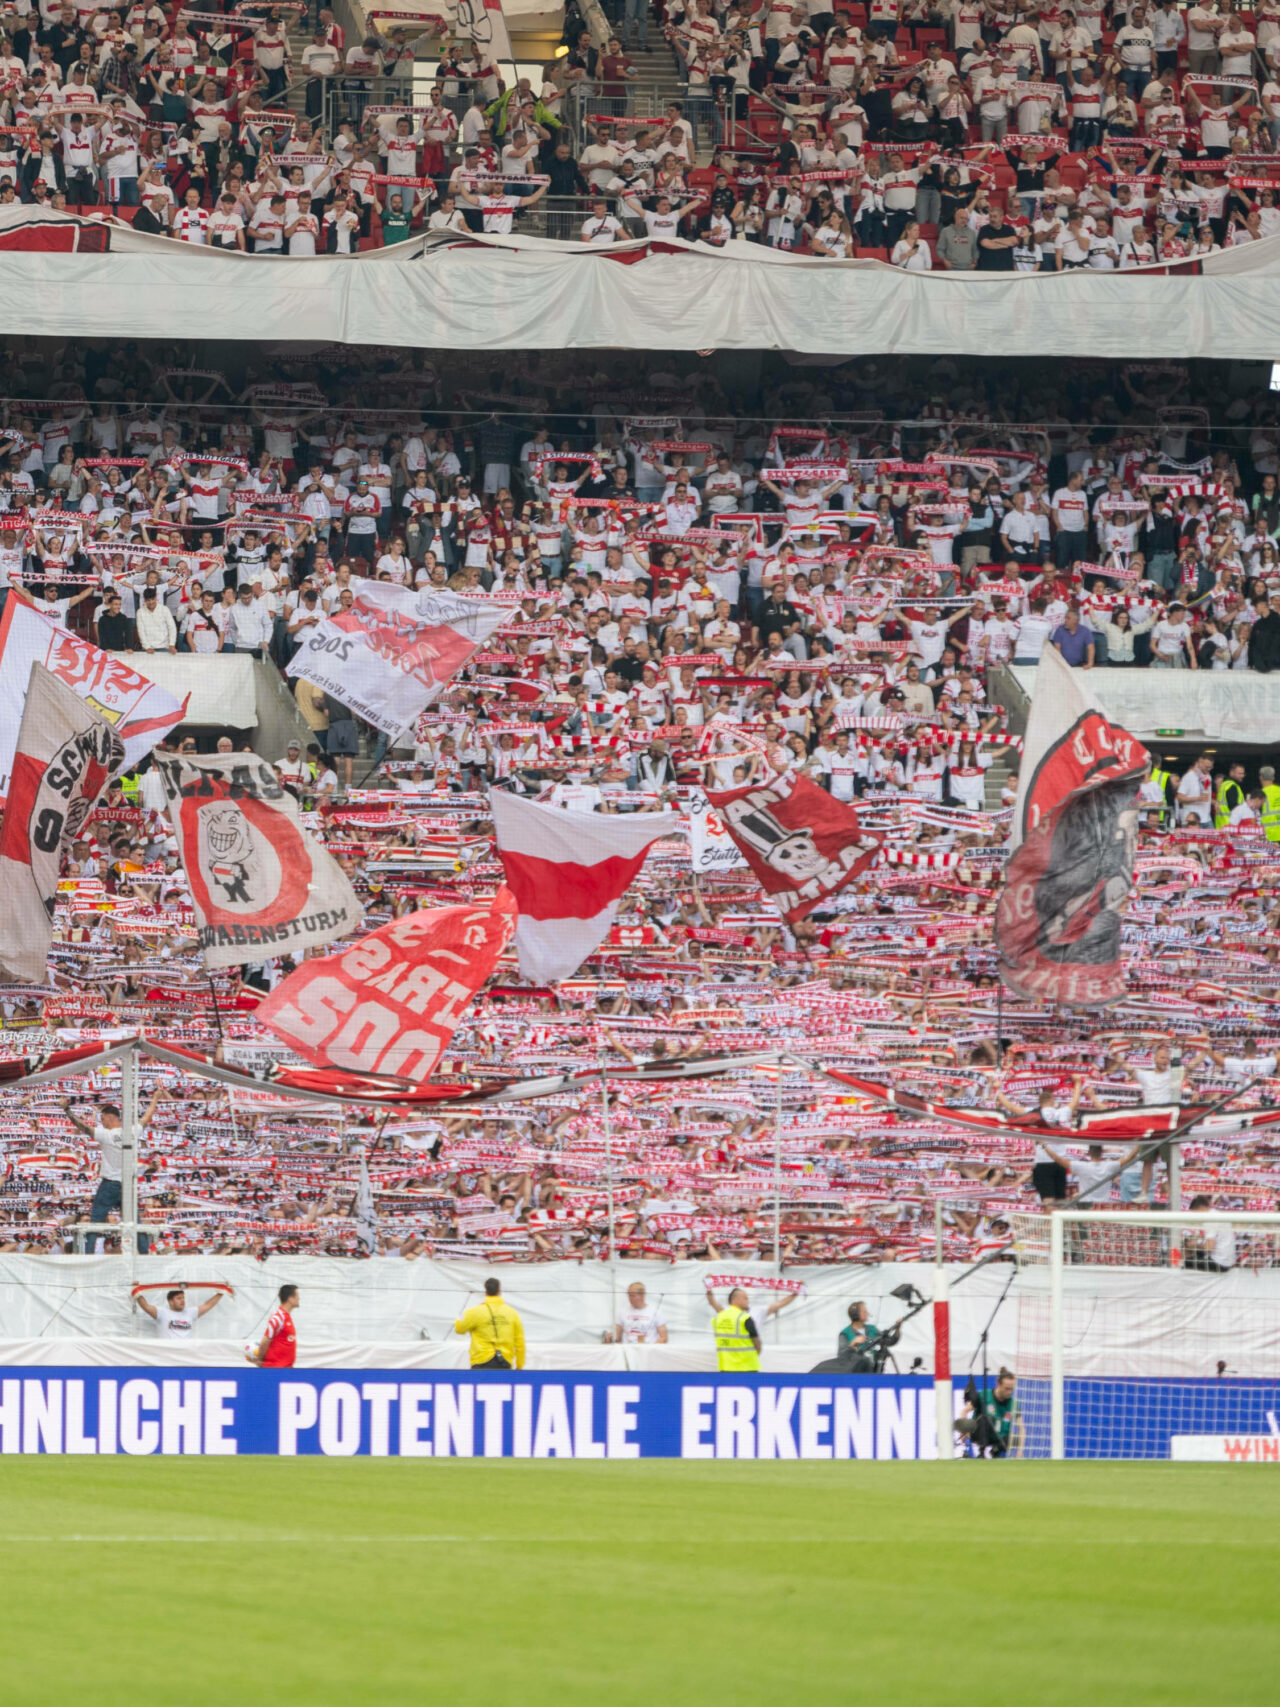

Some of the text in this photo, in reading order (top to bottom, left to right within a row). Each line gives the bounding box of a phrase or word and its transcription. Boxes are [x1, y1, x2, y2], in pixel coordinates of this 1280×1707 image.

[885, 143, 925, 151] STUTTGART
[290, 155, 326, 164] Stuttgart
[476, 174, 531, 182] STUTTGART
[95, 543, 153, 555] STUTTGART
[105, 694, 119, 704] 93
[198, 906, 349, 950] WABENSTURM
[278, 1382, 640, 1457] POTENTIALE
